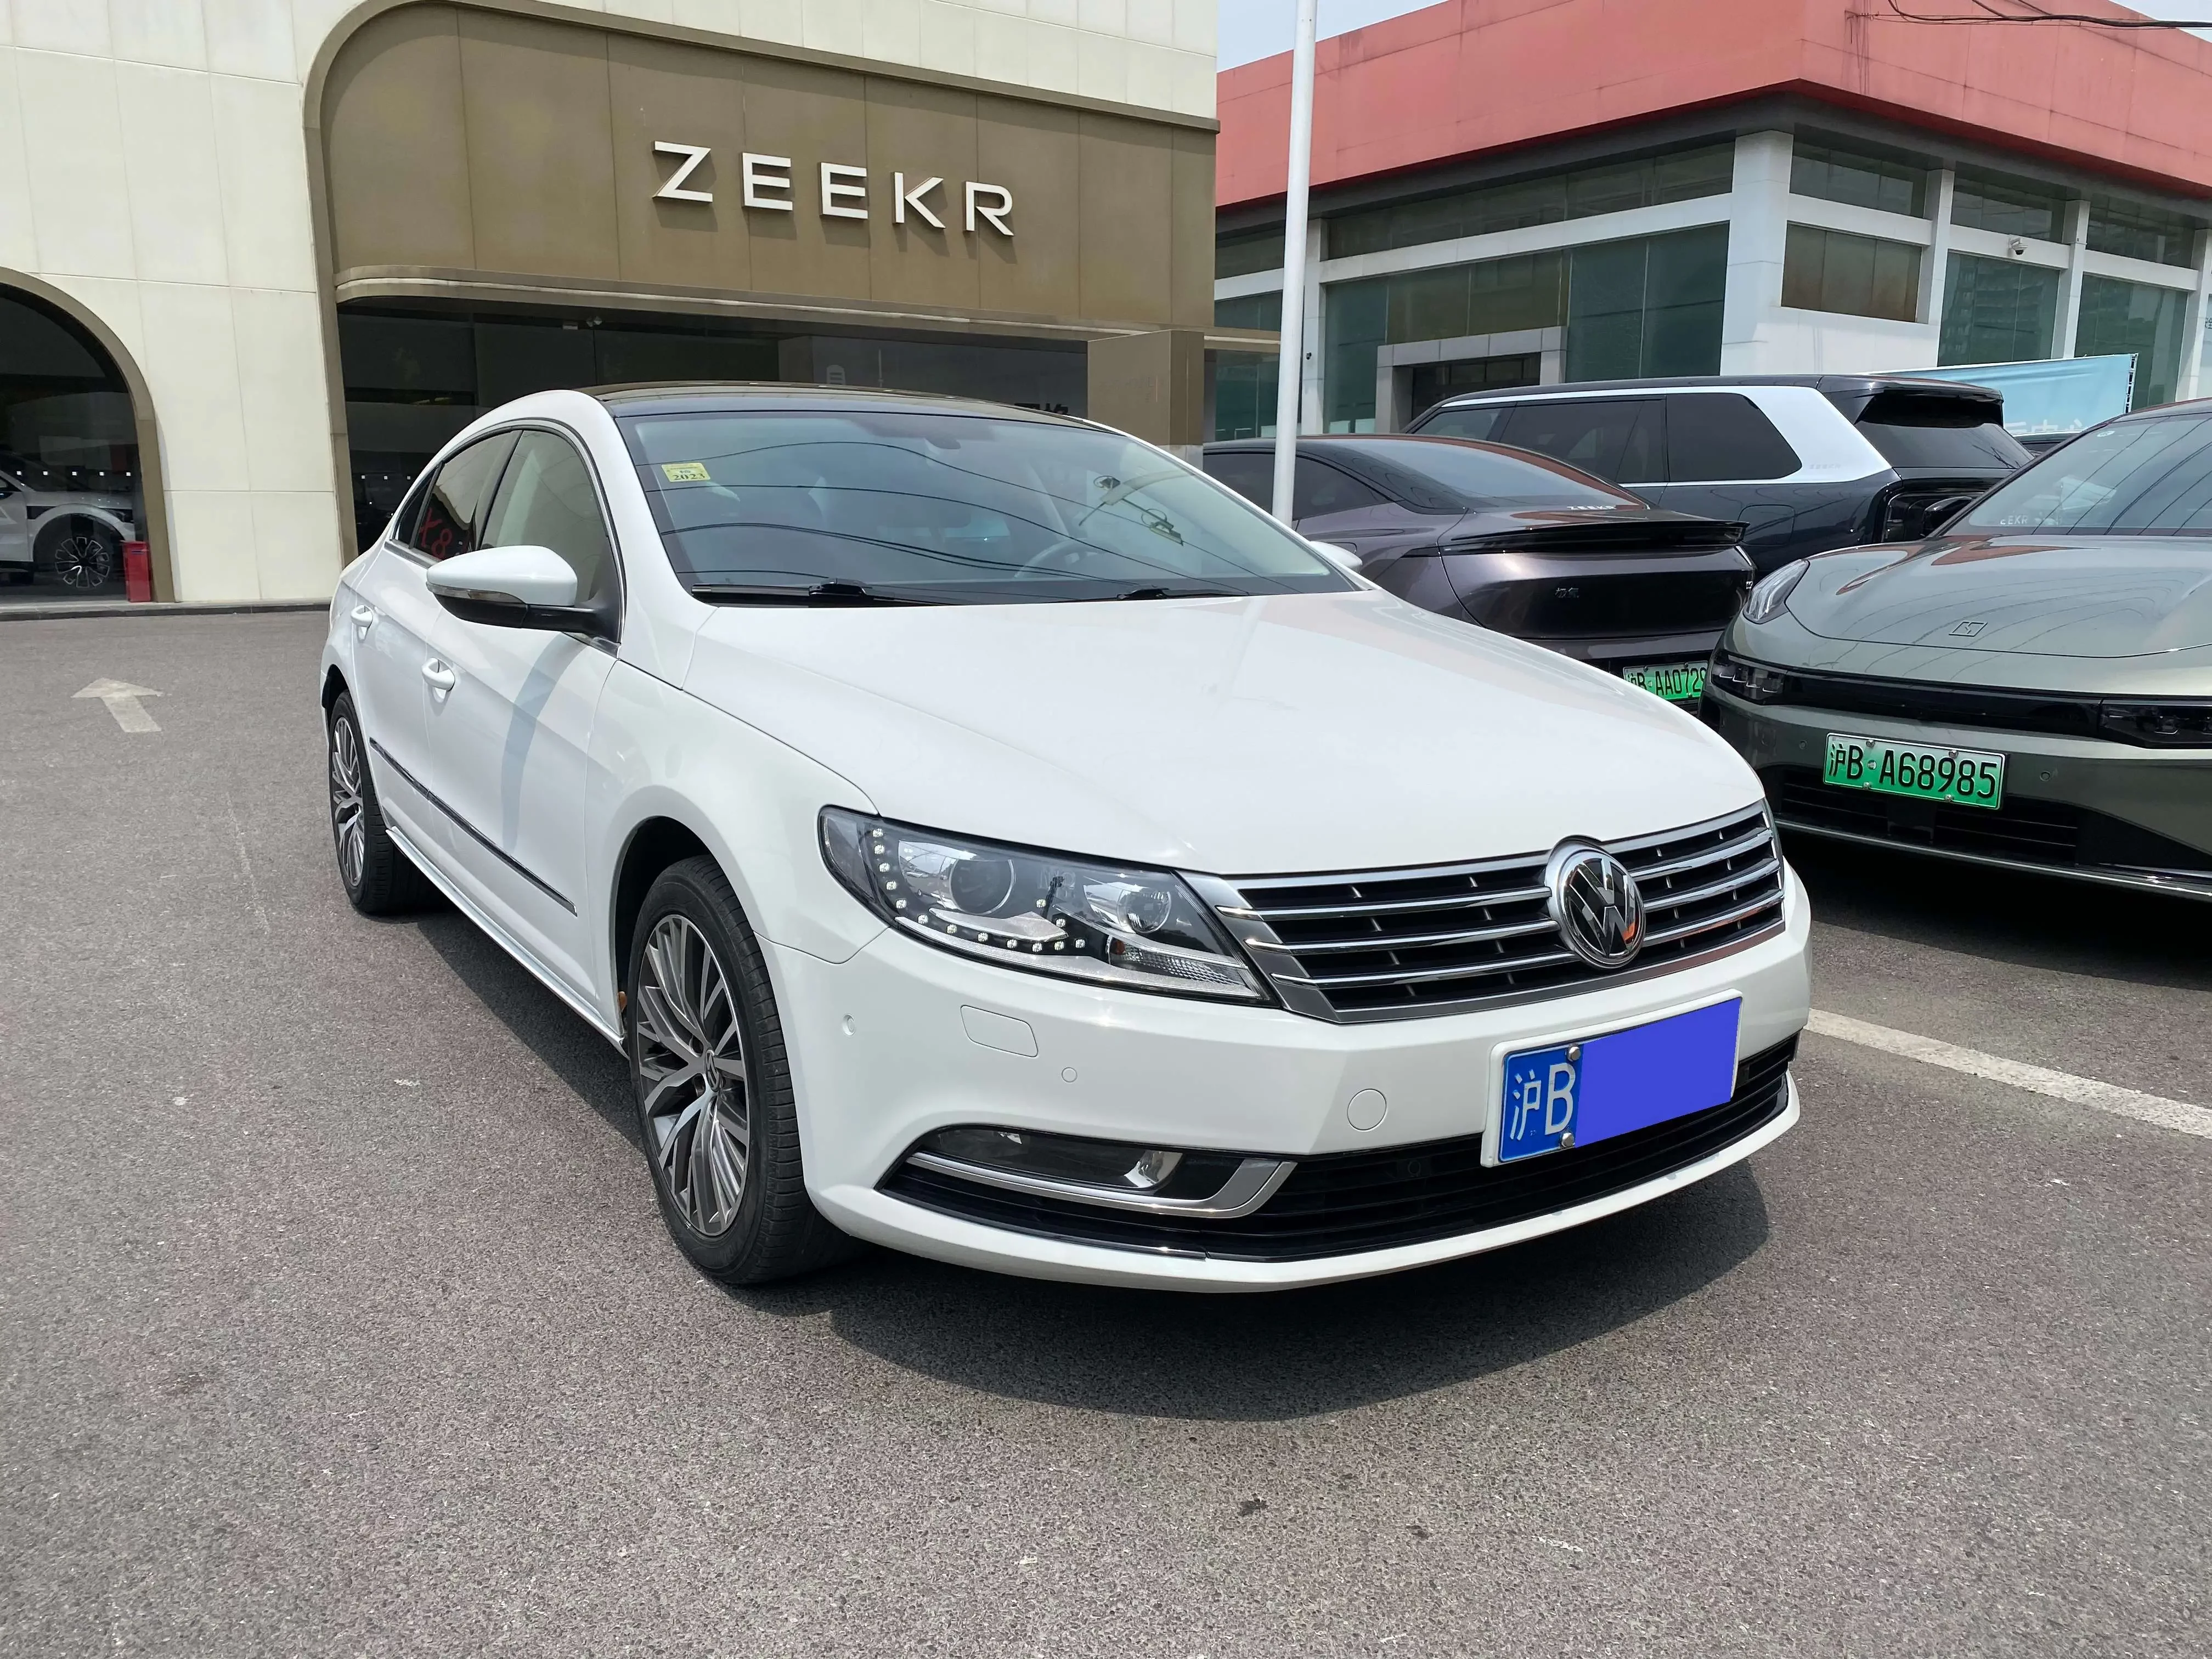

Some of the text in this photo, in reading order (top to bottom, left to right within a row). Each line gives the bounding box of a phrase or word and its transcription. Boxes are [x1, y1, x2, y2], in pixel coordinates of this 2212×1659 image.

[652, 140, 1014, 237] ZEEKR
[672, 473, 706, 481] 2023
[1829, 742, 1998, 799] 沪B A68985
[1509, 1062, 1577, 1141] 沪B
